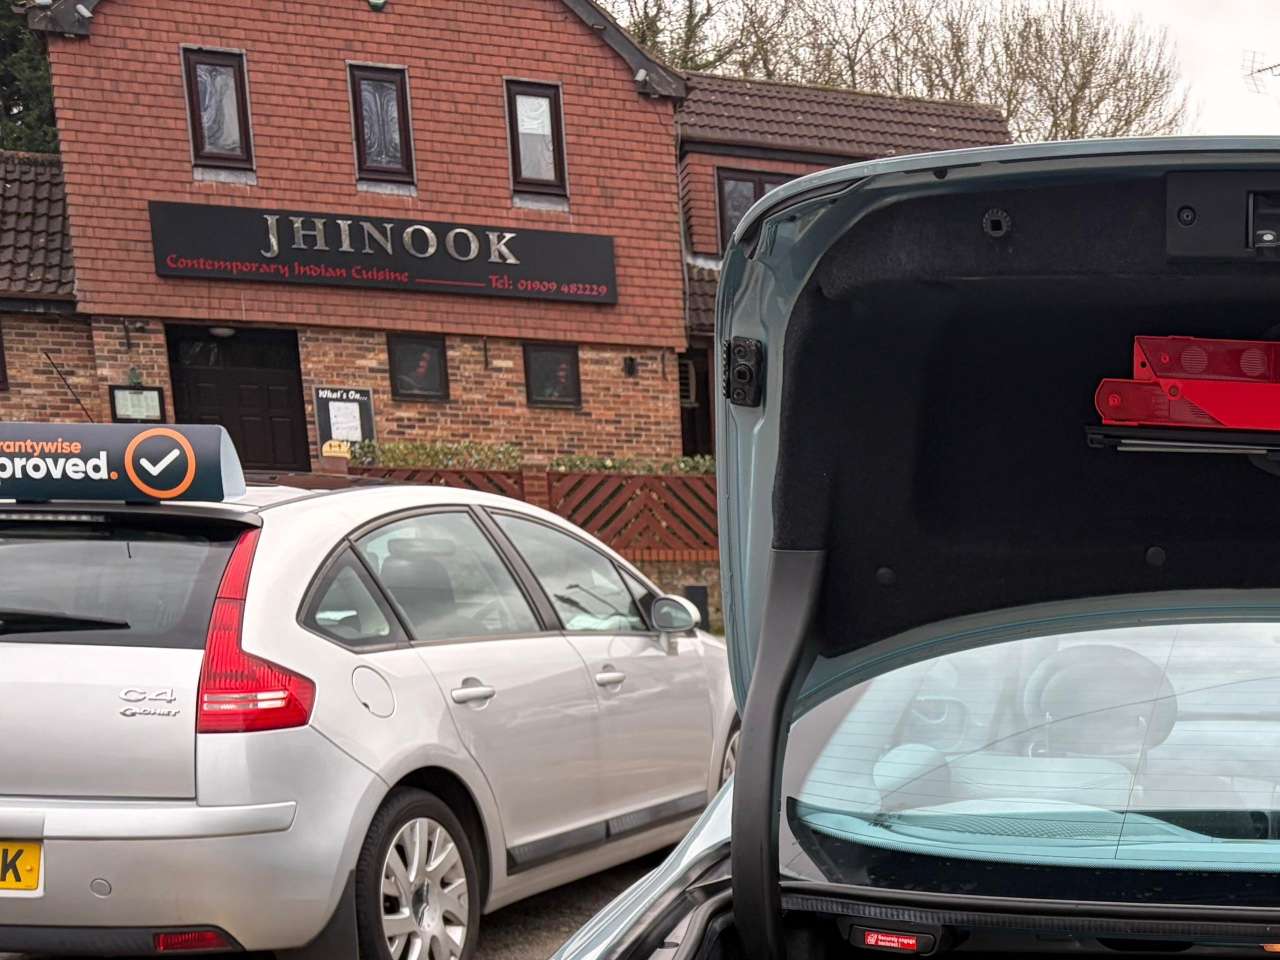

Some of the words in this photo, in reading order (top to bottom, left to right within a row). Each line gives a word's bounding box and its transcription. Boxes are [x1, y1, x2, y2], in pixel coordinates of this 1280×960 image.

[260, 214, 521, 265] JHINOOK
[166, 254, 290, 278] Contemporary
[294, 261, 347, 279] Indian
[351, 265, 409, 284] Cuisine
[488, 272, 513, 290] Tel:
[517, 278, 558, 293] 01909
[318, 388, 347, 400] What's
[119, 687, 177, 704] C4
